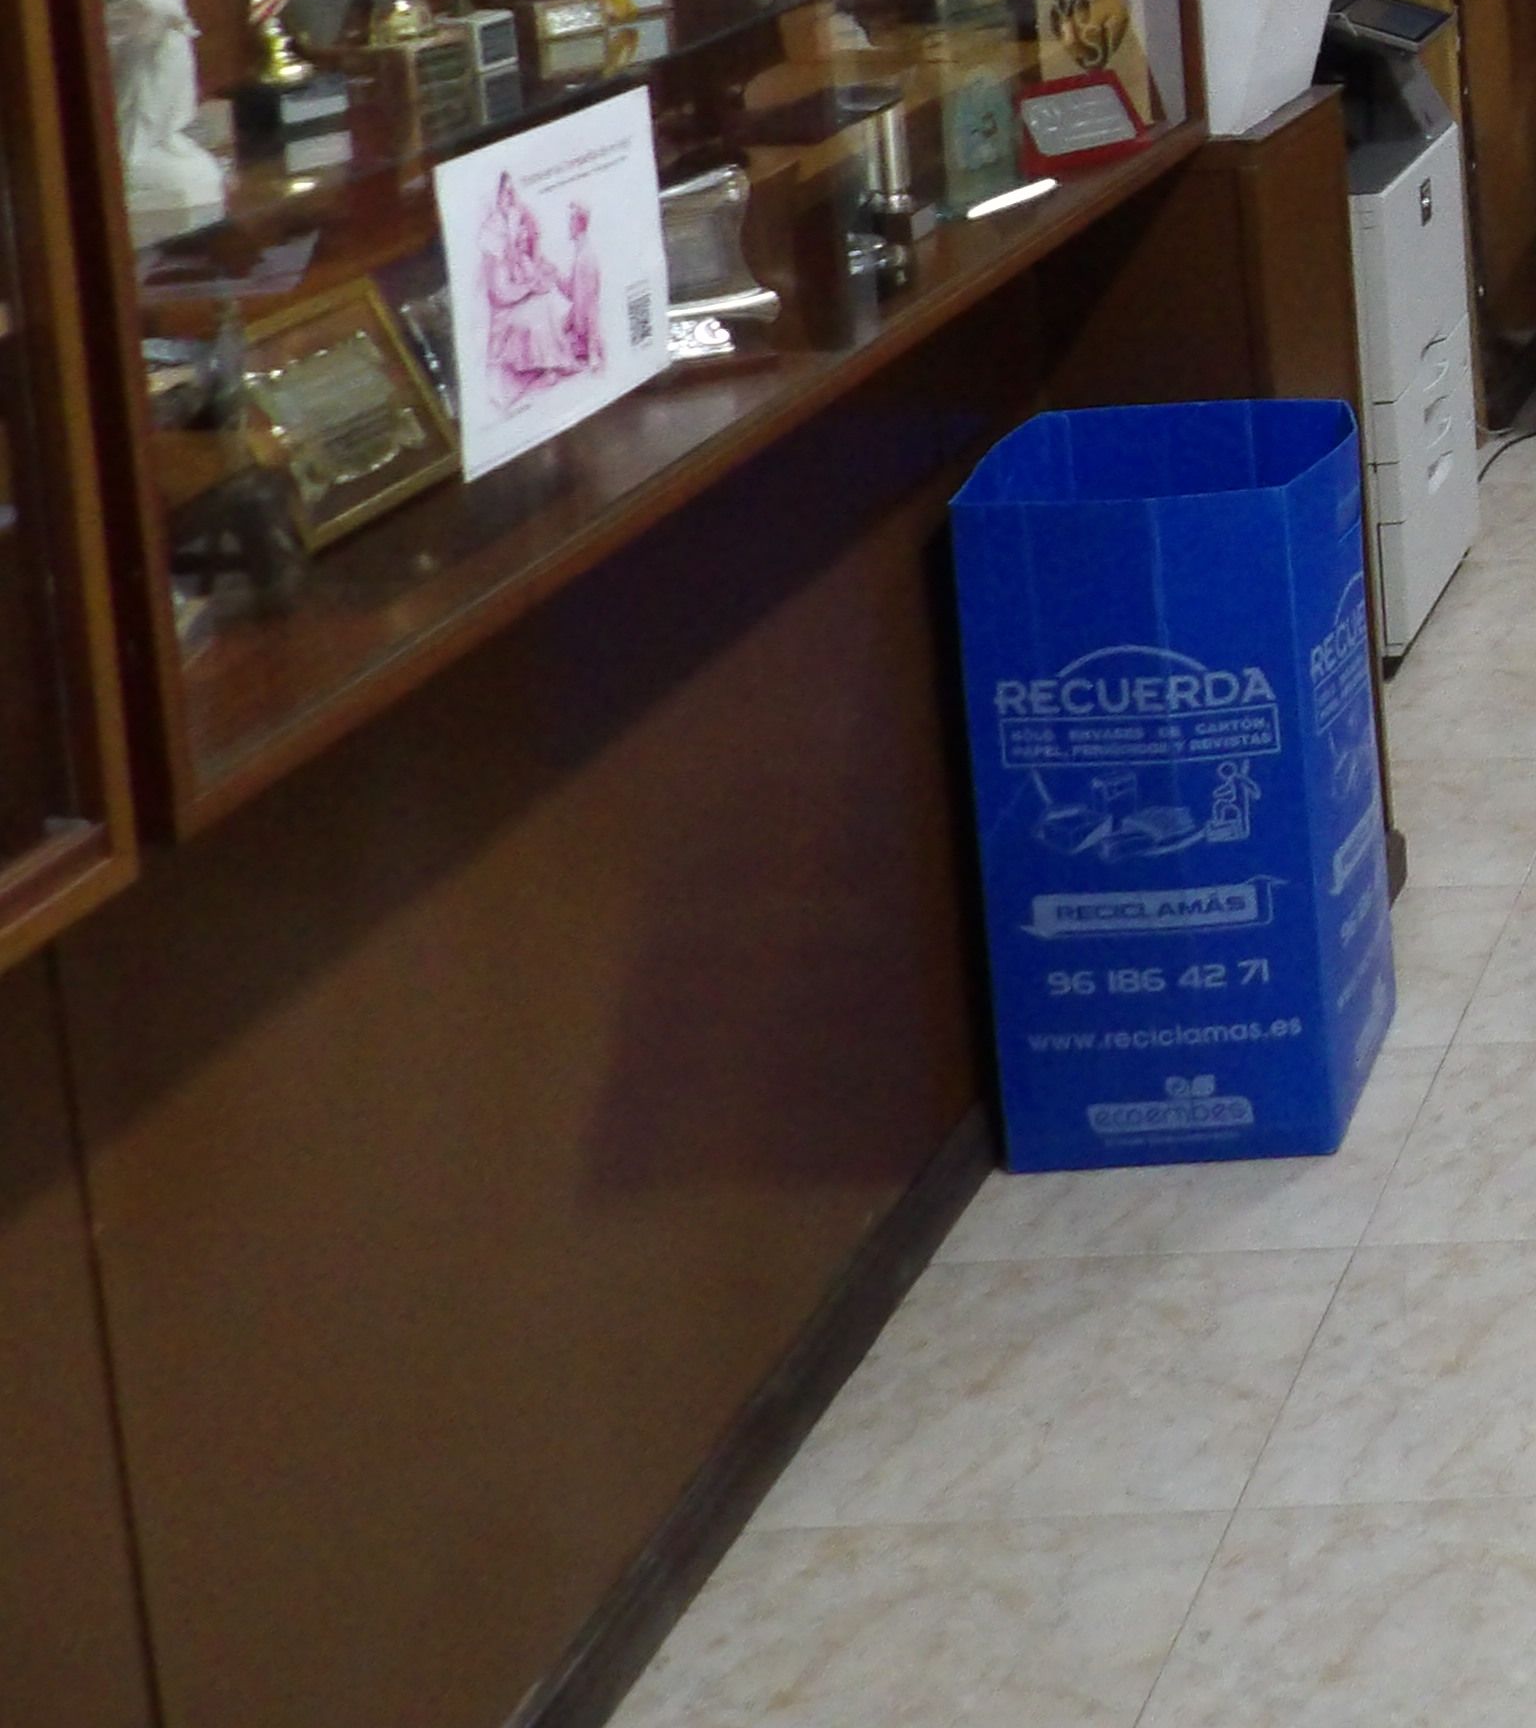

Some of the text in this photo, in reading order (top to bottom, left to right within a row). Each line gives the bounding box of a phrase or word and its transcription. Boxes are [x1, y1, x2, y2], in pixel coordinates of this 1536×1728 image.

[993, 667, 1277, 715] RECUERDA
[1056, 894, 1247, 922] RECICLAMÁS
[1047, 959, 1269, 996] 96 186 42 71
[1028, 1016, 1302, 1052] www.reciclamas.es
